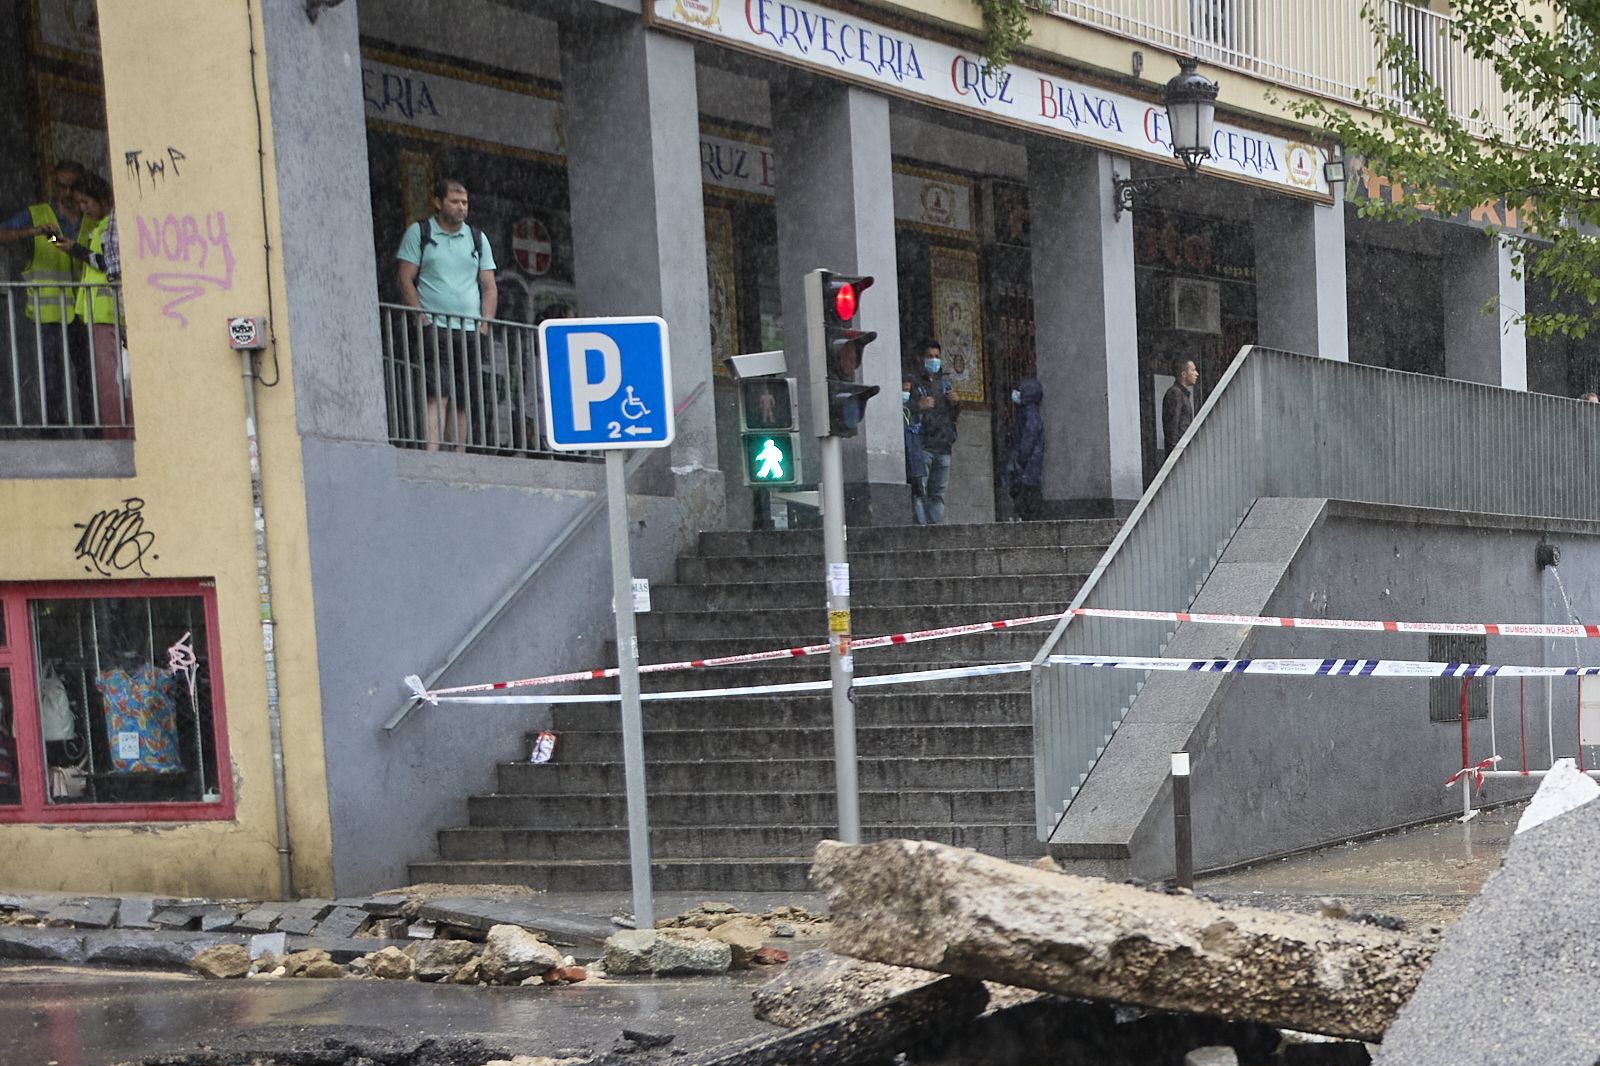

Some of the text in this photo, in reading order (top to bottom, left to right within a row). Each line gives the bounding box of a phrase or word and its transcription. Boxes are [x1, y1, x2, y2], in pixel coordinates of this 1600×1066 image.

[951, 54, 1014, 106] CRUZ
[1039, 78, 1124, 133] BLANCA
[1144, 106, 1280, 174] CECERIA
[567, 332, 622, 431] P
[608, 421, 622, 438] 2
[1505, 625, 1579, 635] BOMBEROS NO PASAR
